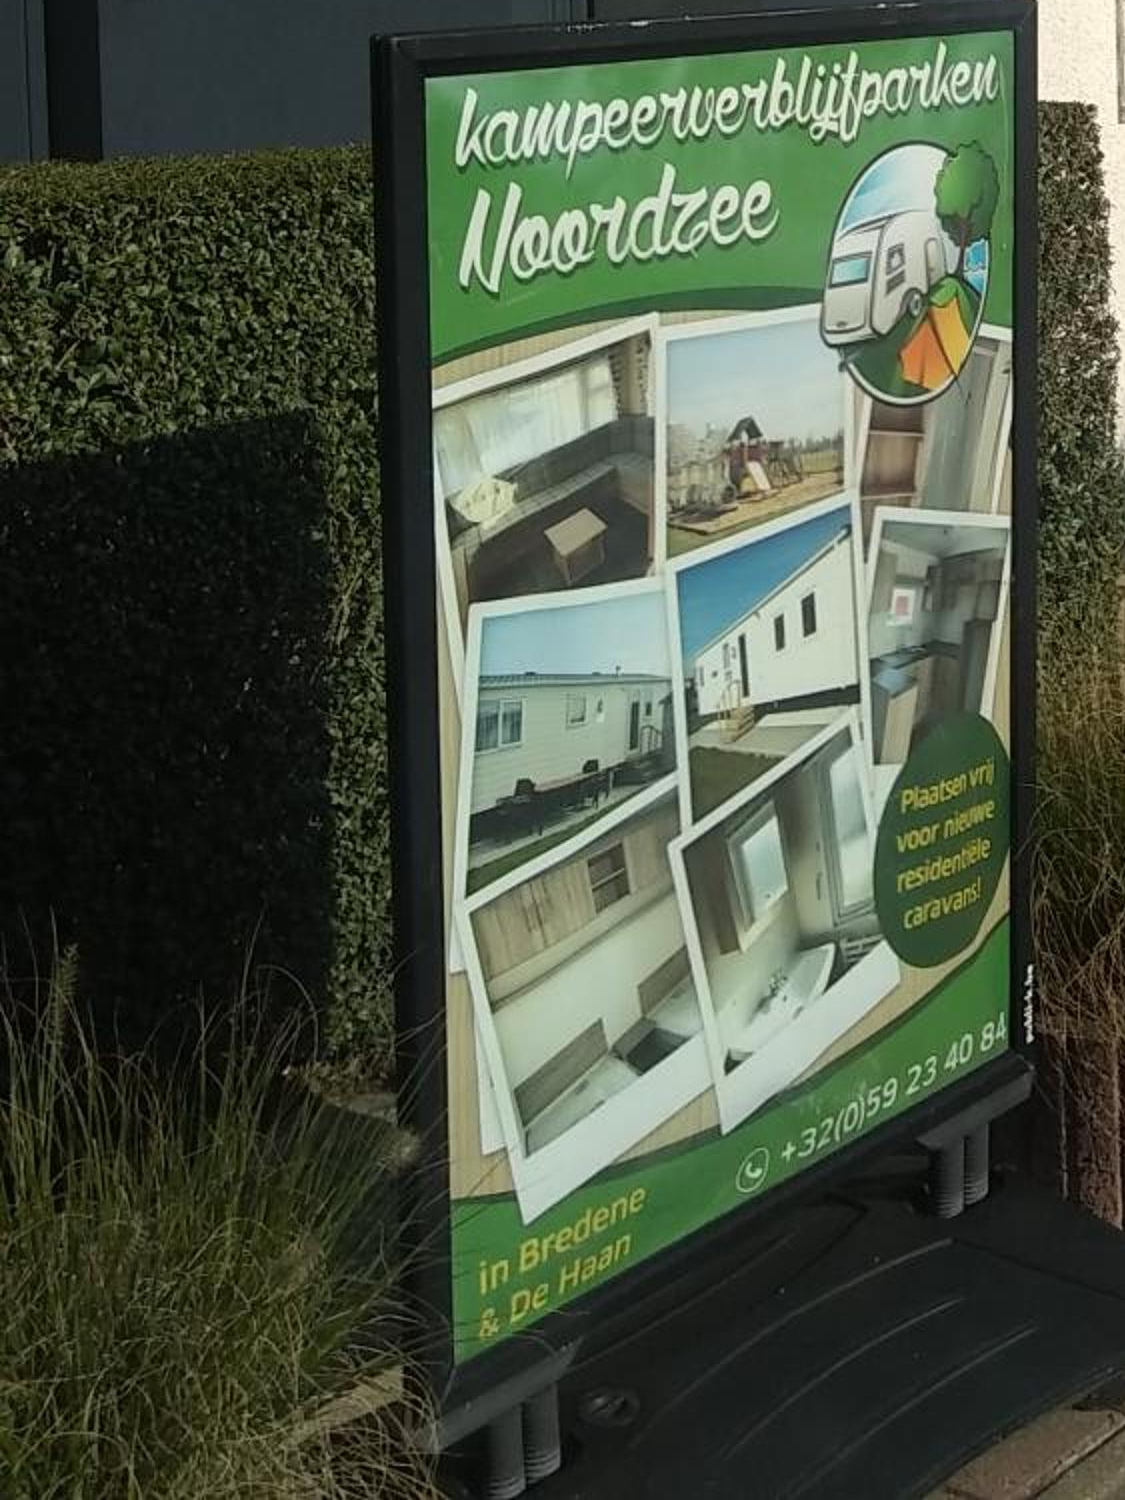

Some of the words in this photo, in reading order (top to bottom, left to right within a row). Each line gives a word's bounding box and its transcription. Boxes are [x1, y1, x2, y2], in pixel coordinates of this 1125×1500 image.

[458, 164, 780, 293] Noordzee
[902, 766, 967, 814] Plaatsen
[969, 756, 995, 786] vrij
[896, 822, 938, 853] voor
[944, 800, 995, 840] nieuwe
[896, 837, 992, 894] residentiële
[903, 877, 982, 930] caravans!
[781, 1077, 899, 1162] +32(0)59
[905, 1055, 939, 1096] 23
[943, 1033, 974, 1072] 40
[980, 1011, 1007, 1052] 84
[479, 1259, 510, 1296] in
[519, 1187, 646, 1274] Bredene
[479, 1307, 500, 1338] &
[510, 1282, 549, 1325] De
[558, 1234, 632, 1295] Haan
